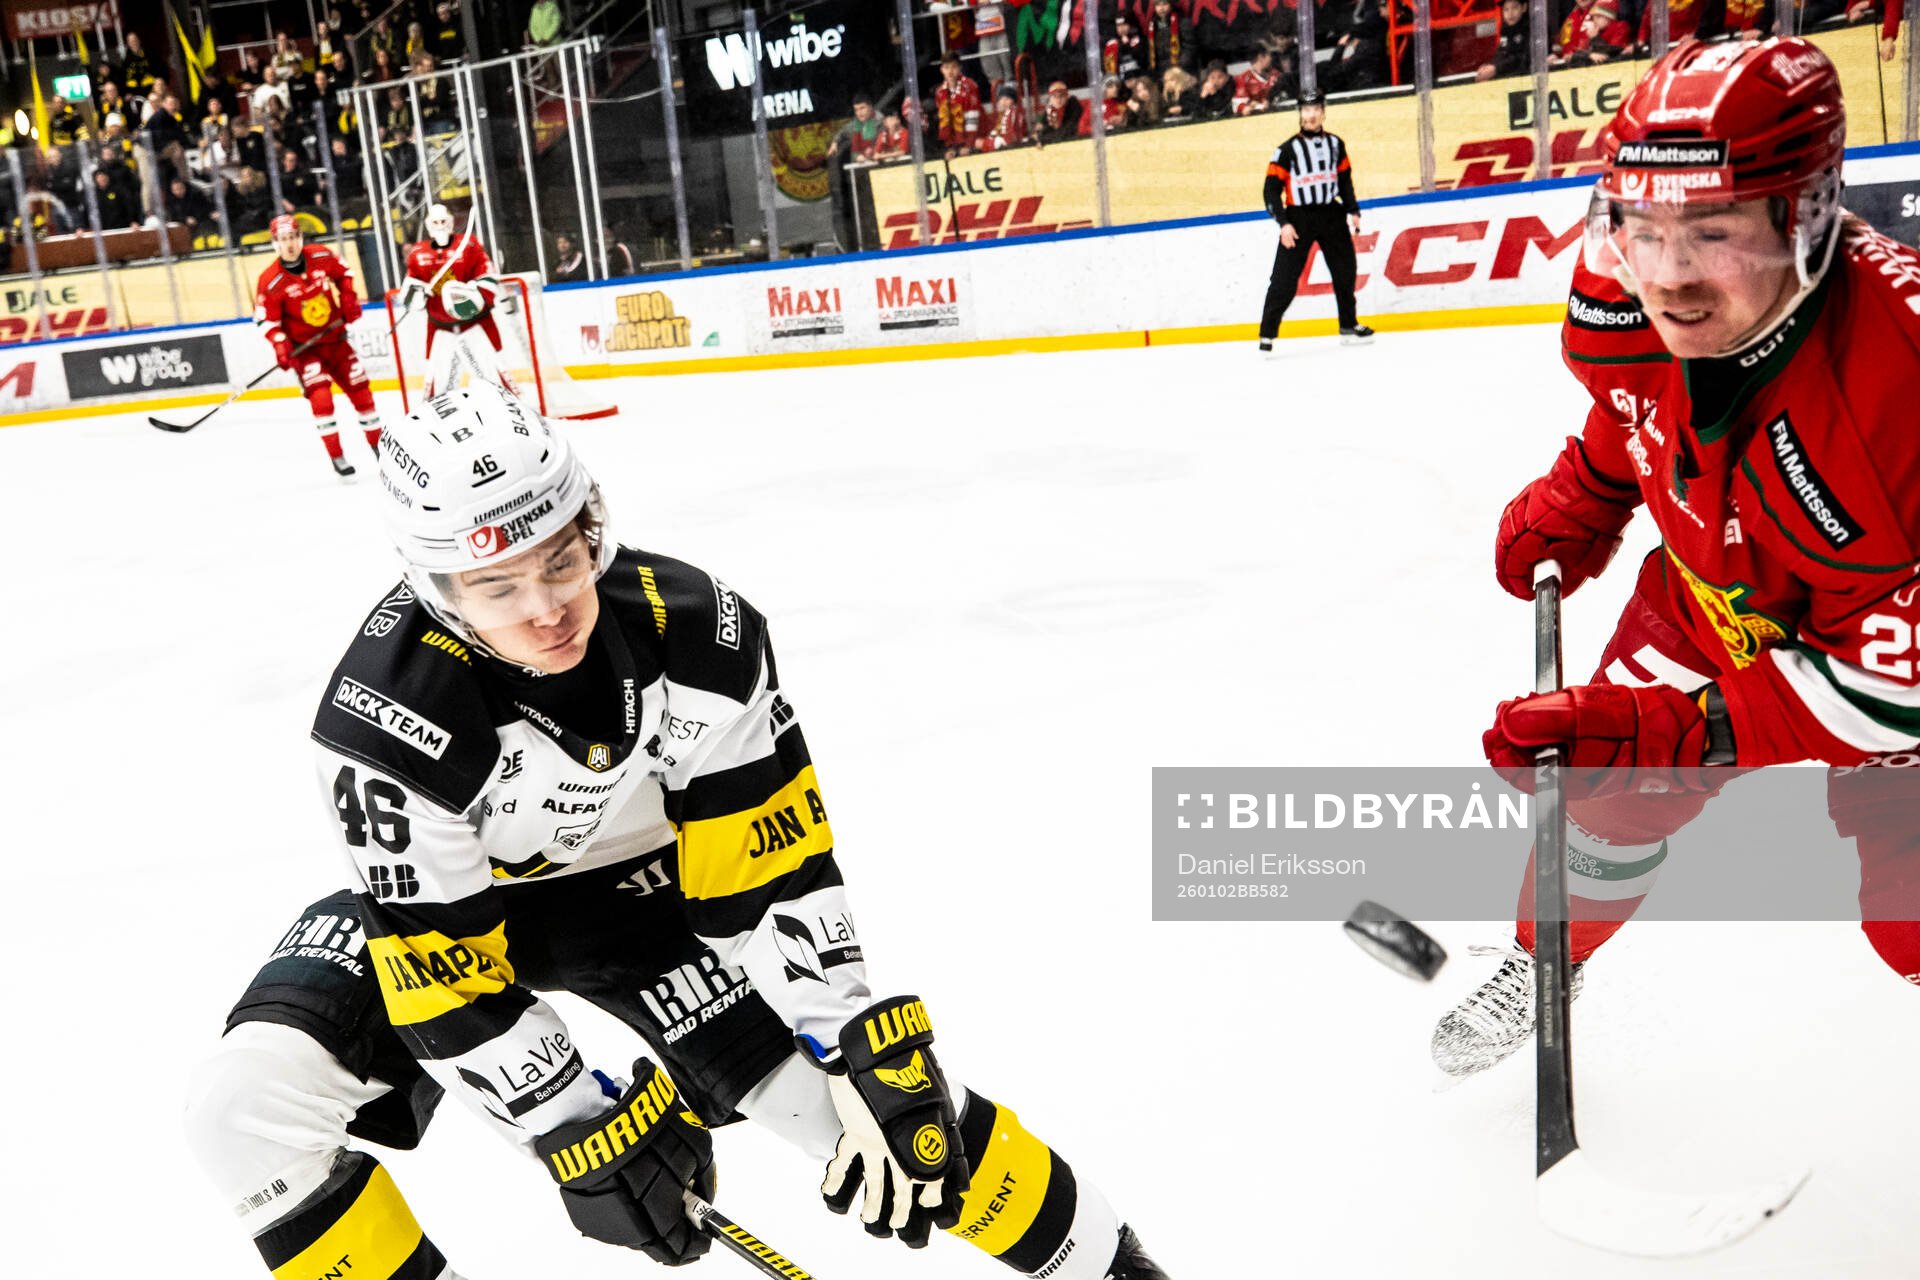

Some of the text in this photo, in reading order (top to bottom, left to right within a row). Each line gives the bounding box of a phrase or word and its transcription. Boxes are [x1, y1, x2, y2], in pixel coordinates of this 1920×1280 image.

[16, 4, 113, 31] KIOSK
[765, 24, 843, 68] wibe
[1618, 146, 1719, 162] FM Mattsson
[1652, 172, 1721, 188] SVENSKA
[616, 291, 674, 323] EURO
[605, 316, 691, 352] JACKPOT
[472, 453, 498, 477] 46
[1772, 419, 1850, 543] FM Mattsson
[473, 491, 534, 524] WARRIOR
[500, 499, 555, 534] SVENSKA
[1861, 613, 1920, 679] 2
[336, 683, 444, 752] DÄCK TEAM
[623, 678, 637, 734] HITACHI
[333, 765, 412, 855] 46
[750, 805, 807, 859] JAN
[1567, 858, 1603, 879] roup
[294, 946, 364, 977] RENTAL
[662, 979, 758, 1045] ROAD RENTA
[499, 1032, 571, 1092] LaVie
[534, 1061, 581, 1102] Behandling
